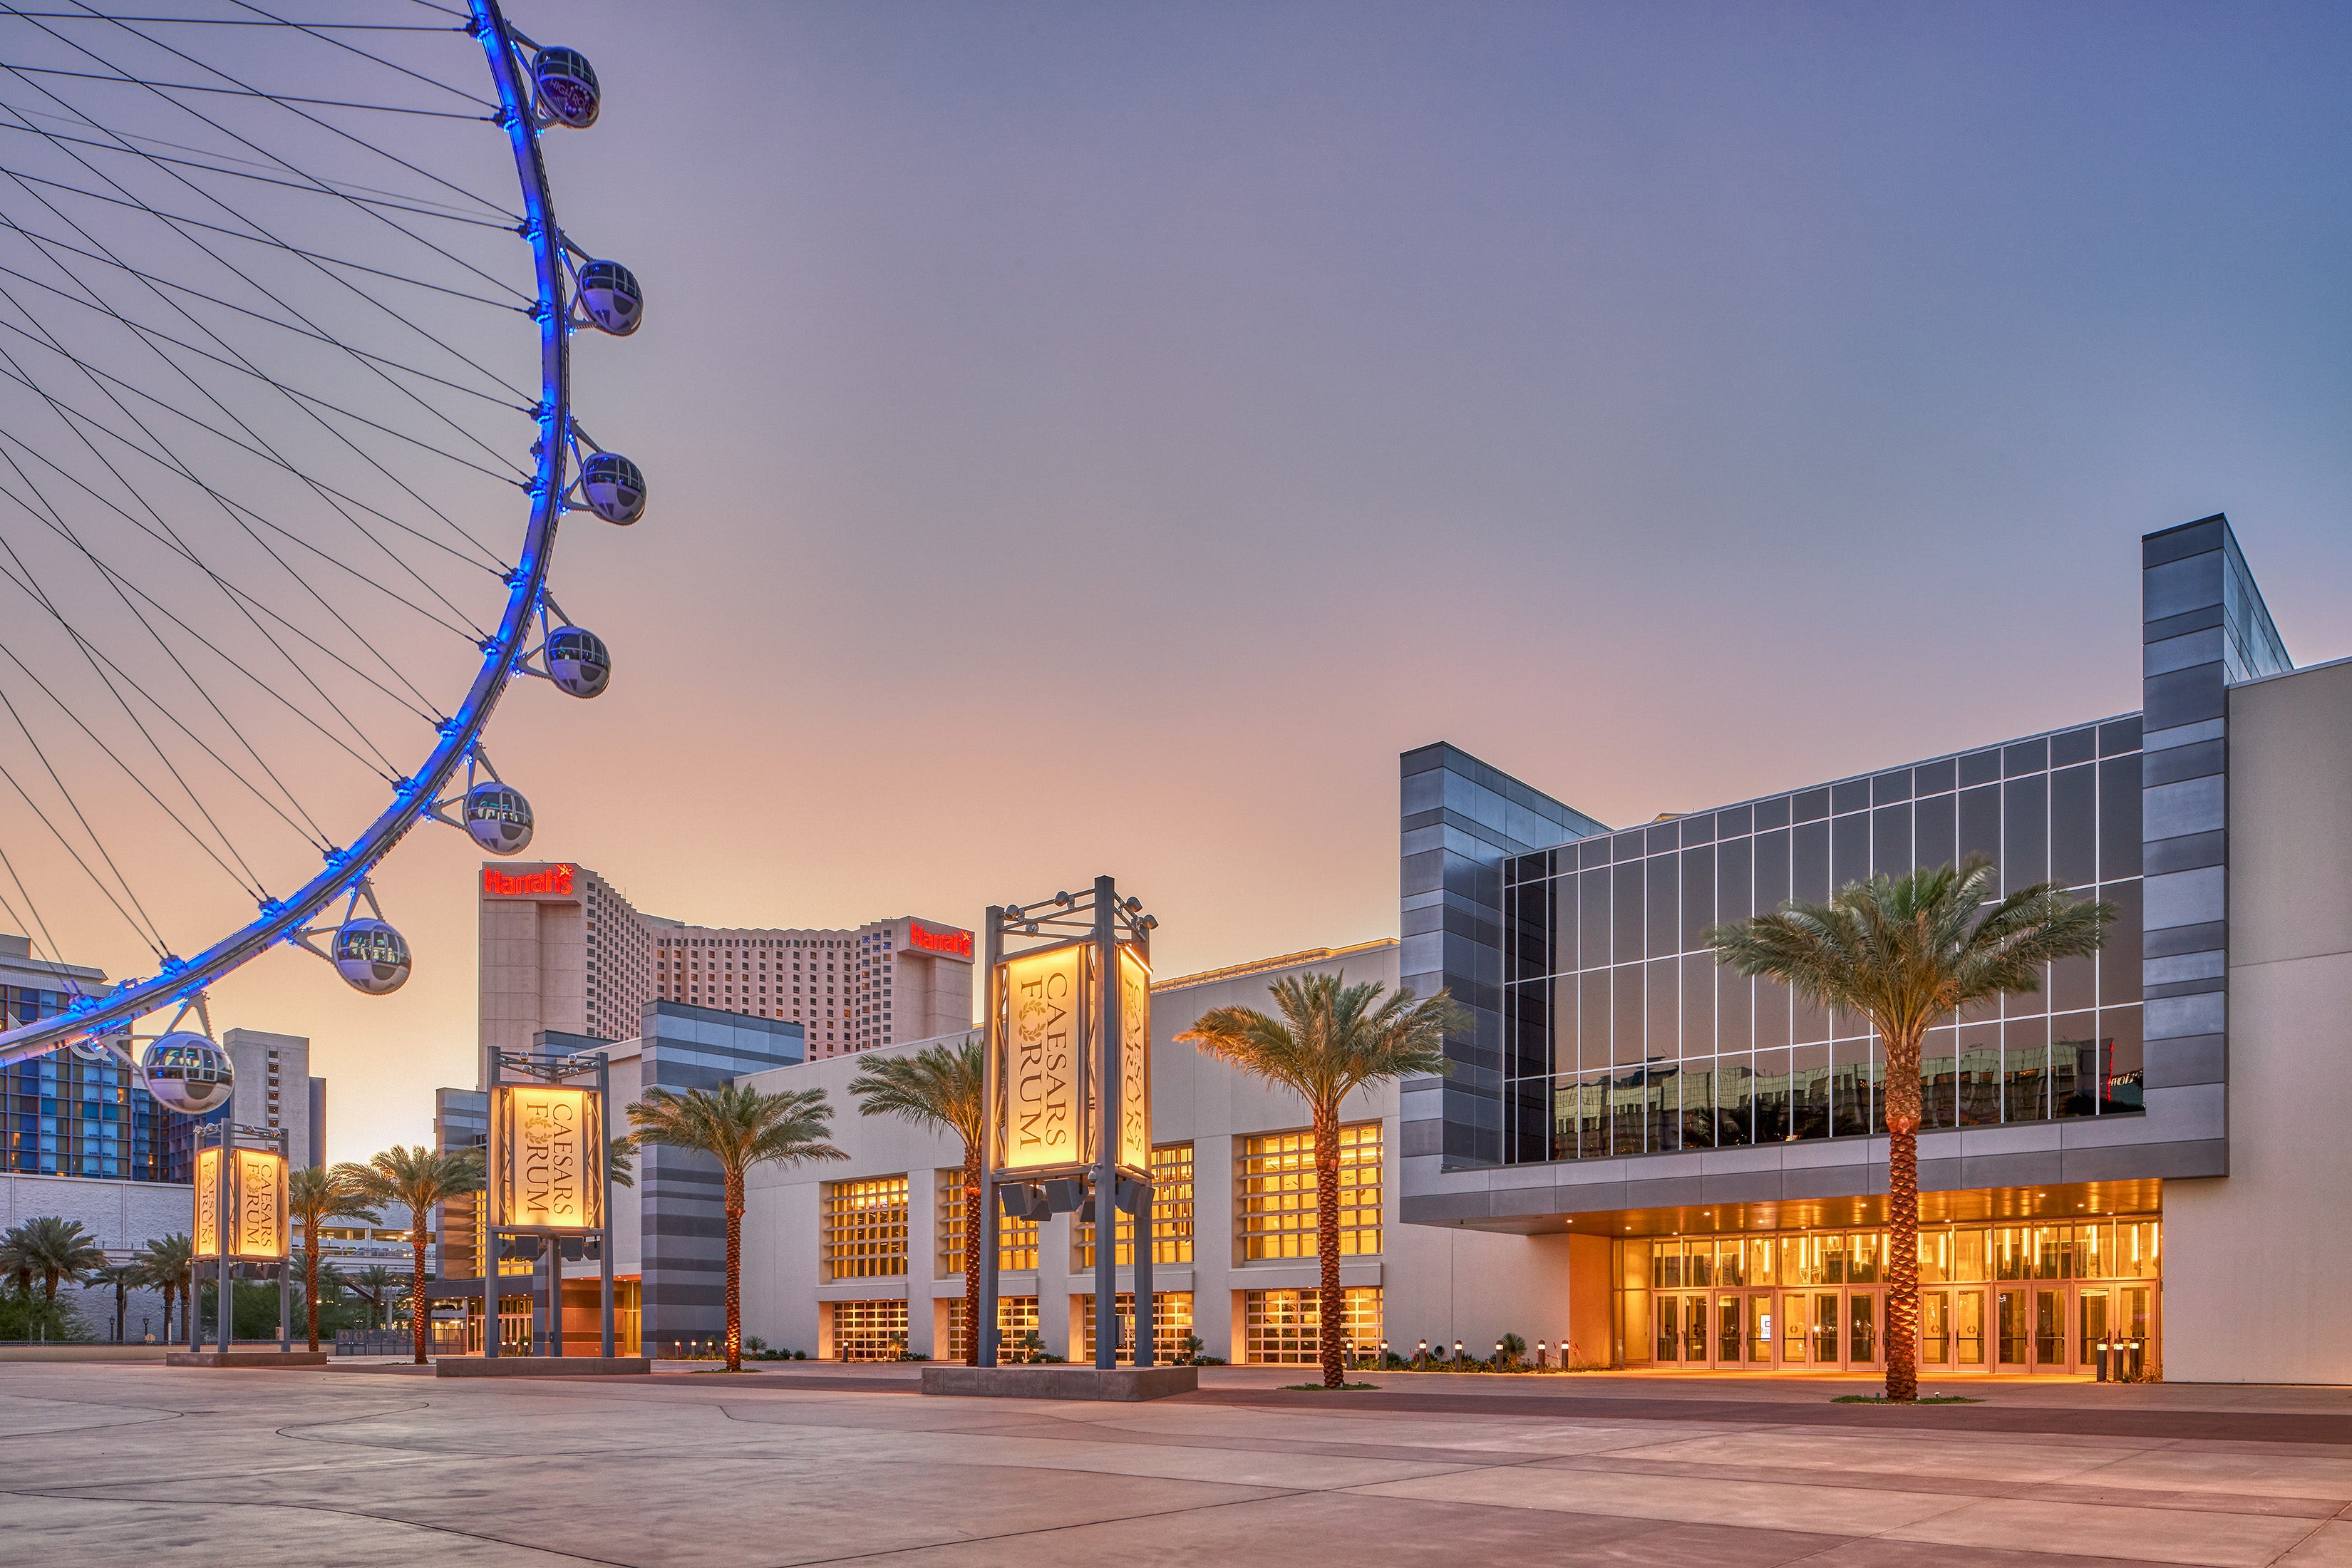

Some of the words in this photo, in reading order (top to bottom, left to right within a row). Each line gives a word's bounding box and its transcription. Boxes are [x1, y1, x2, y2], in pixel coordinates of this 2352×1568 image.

[550, 78, 572, 99] HIGH
[572, 93, 597, 114] ROLLE
[485, 864, 573, 895] Harrah's
[1046, 972, 1068, 1146] CAESARS
[552, 1103, 574, 1214] CAESARS
[261, 1164, 272, 1247] CAESARS
